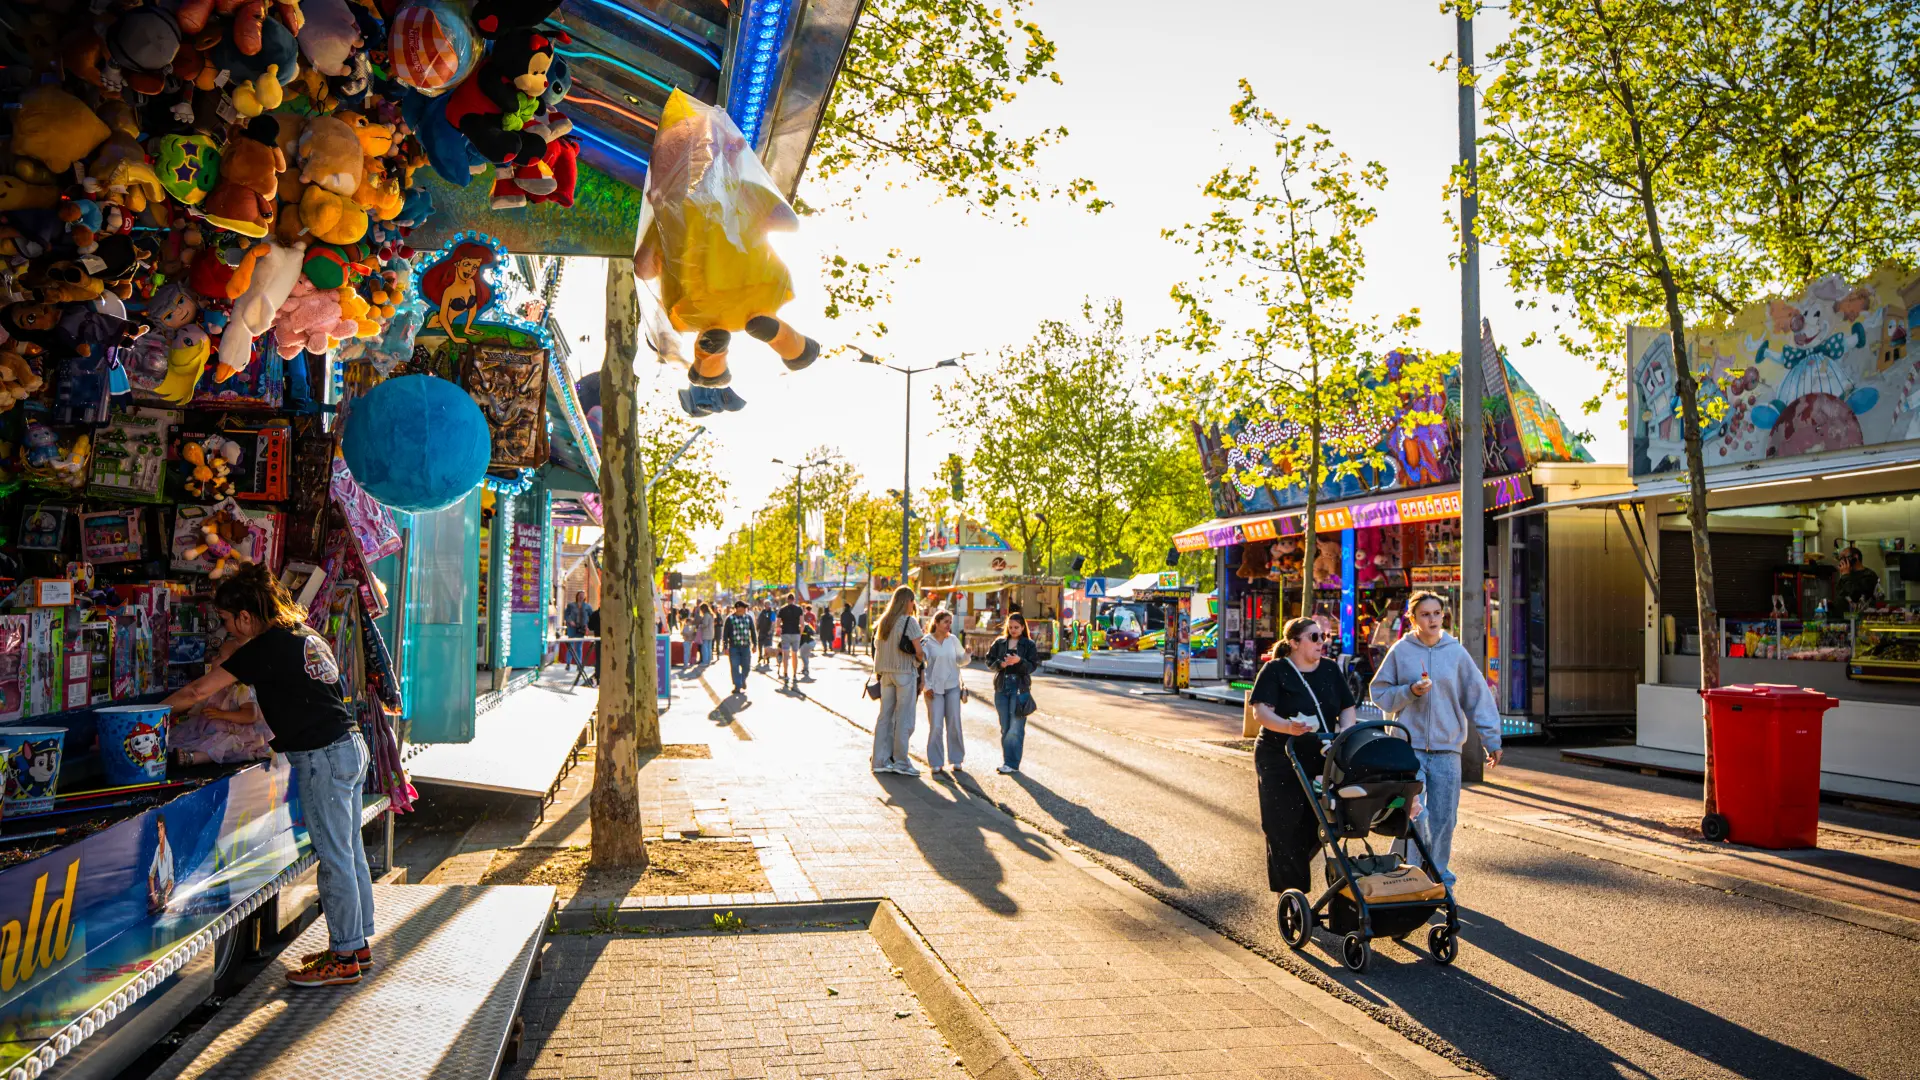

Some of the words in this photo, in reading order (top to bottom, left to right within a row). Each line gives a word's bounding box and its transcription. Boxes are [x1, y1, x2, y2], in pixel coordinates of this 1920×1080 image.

[1493, 475, 1525, 506] 21
[518, 525, 541, 540] Lucky
[519, 537, 541, 548] Plaza
